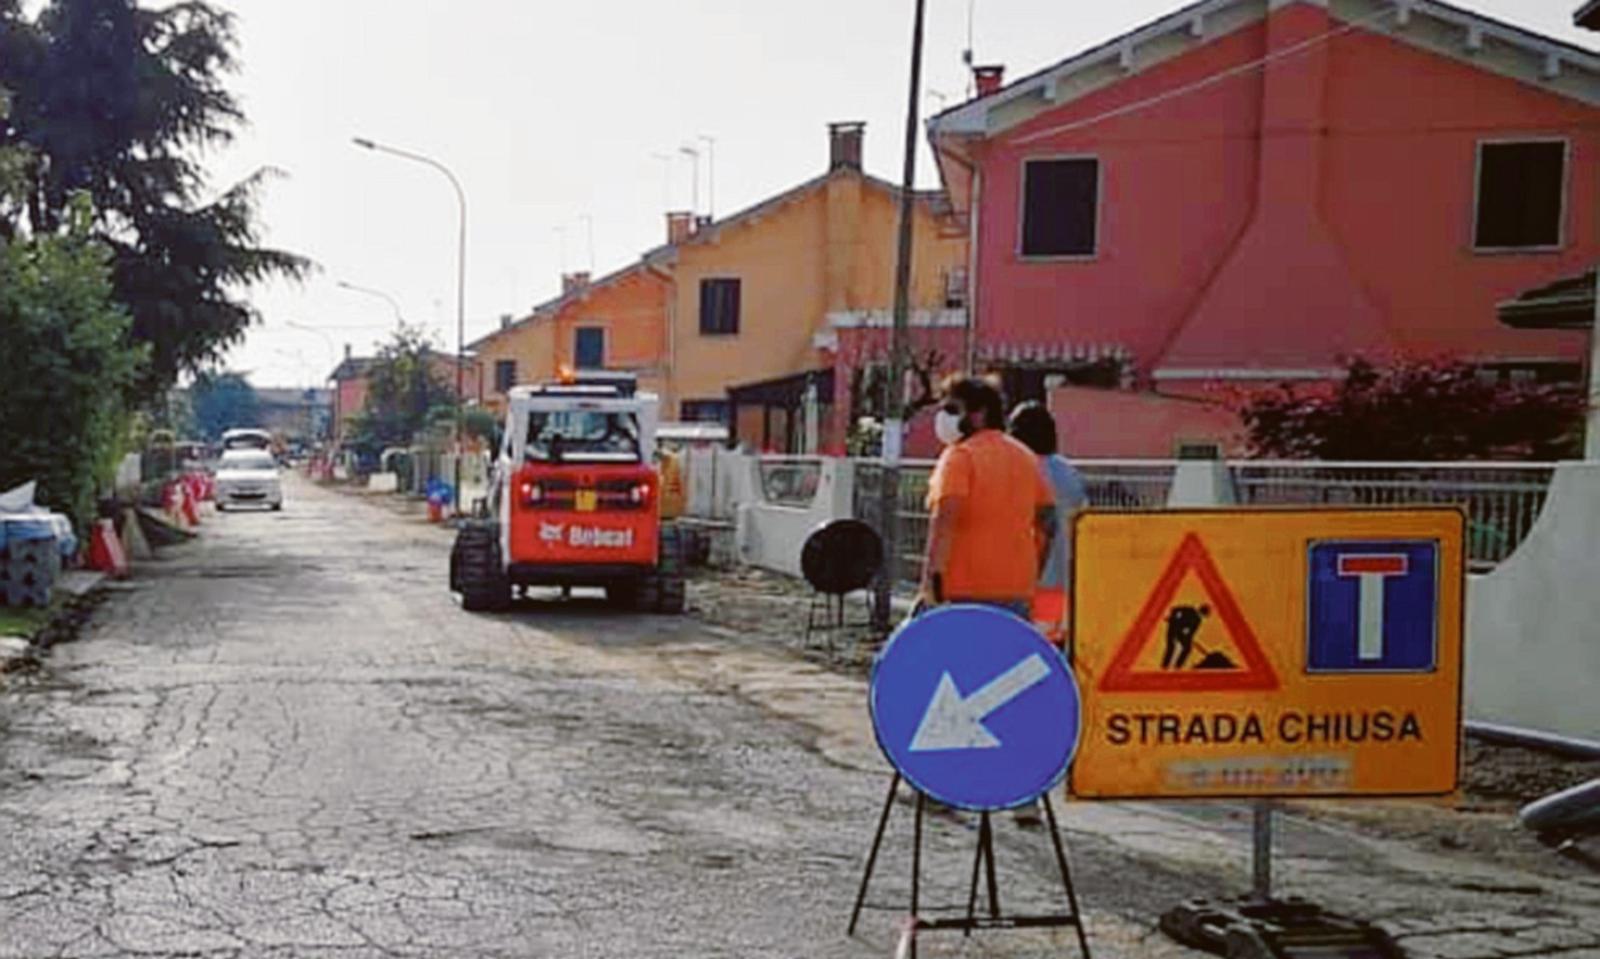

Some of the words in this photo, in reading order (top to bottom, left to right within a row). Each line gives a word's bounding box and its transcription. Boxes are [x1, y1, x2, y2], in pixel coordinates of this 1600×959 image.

[569, 526, 633, 546] Bobcat
[1107, 714, 1264, 744] STRADA
[1278, 712, 1422, 743] CHIUSA
